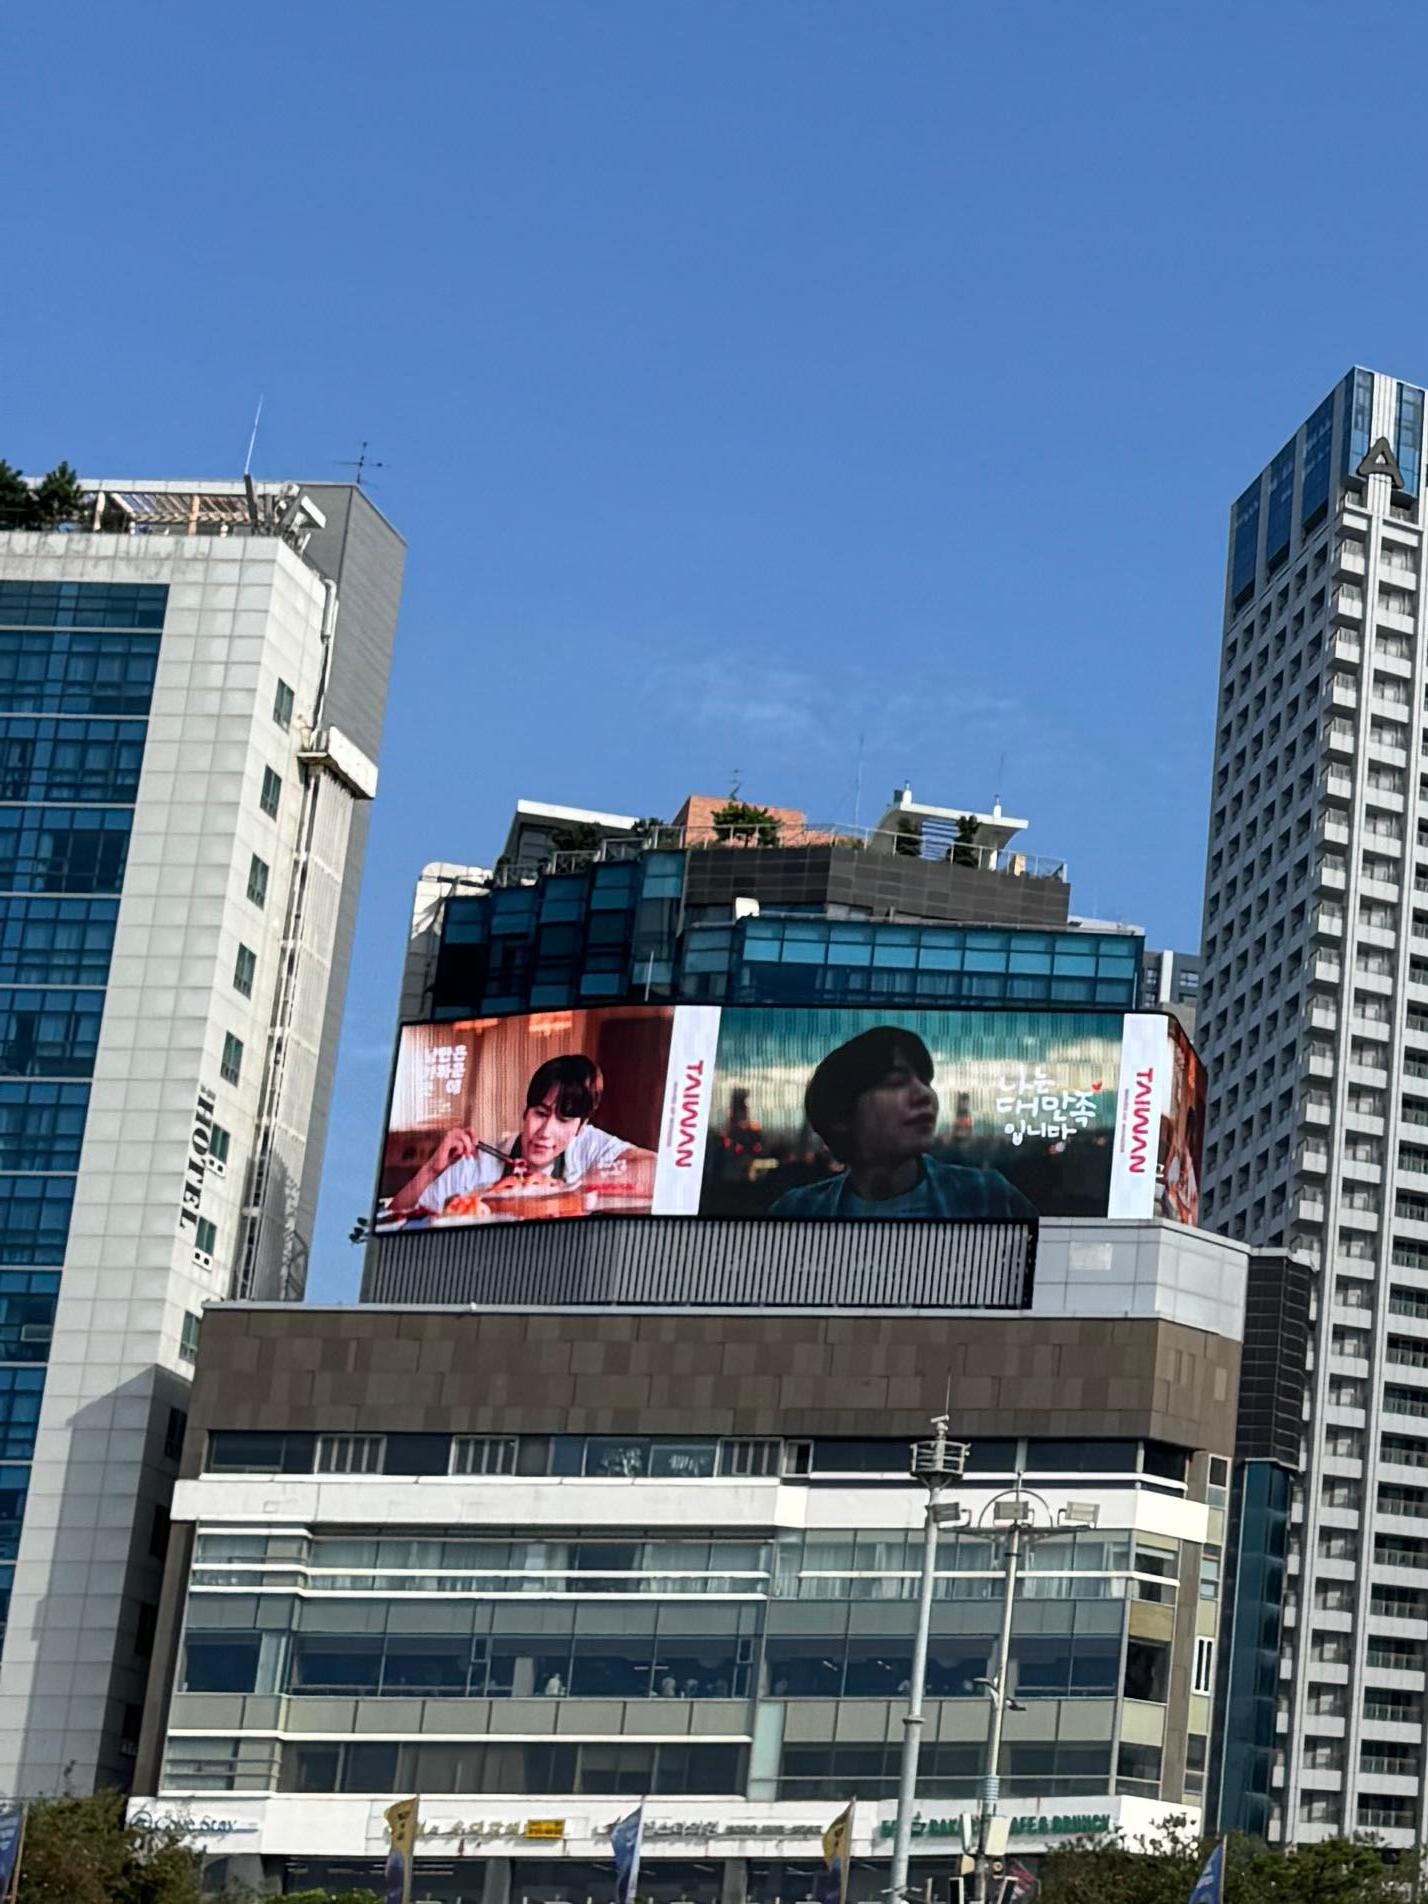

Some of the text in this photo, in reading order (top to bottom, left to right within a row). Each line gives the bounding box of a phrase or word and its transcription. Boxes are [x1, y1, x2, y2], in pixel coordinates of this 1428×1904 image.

[675, 1059, 704, 1168] TAIWAN
[995, 1089, 1097, 1127] 대만족
[998, 1063, 1055, 1094] 나는
[1004, 1120, 1077, 1146] 입니다
[1129, 1067, 1153, 1174] TAIWAN
[179, 1093, 216, 1230] HOTEL
